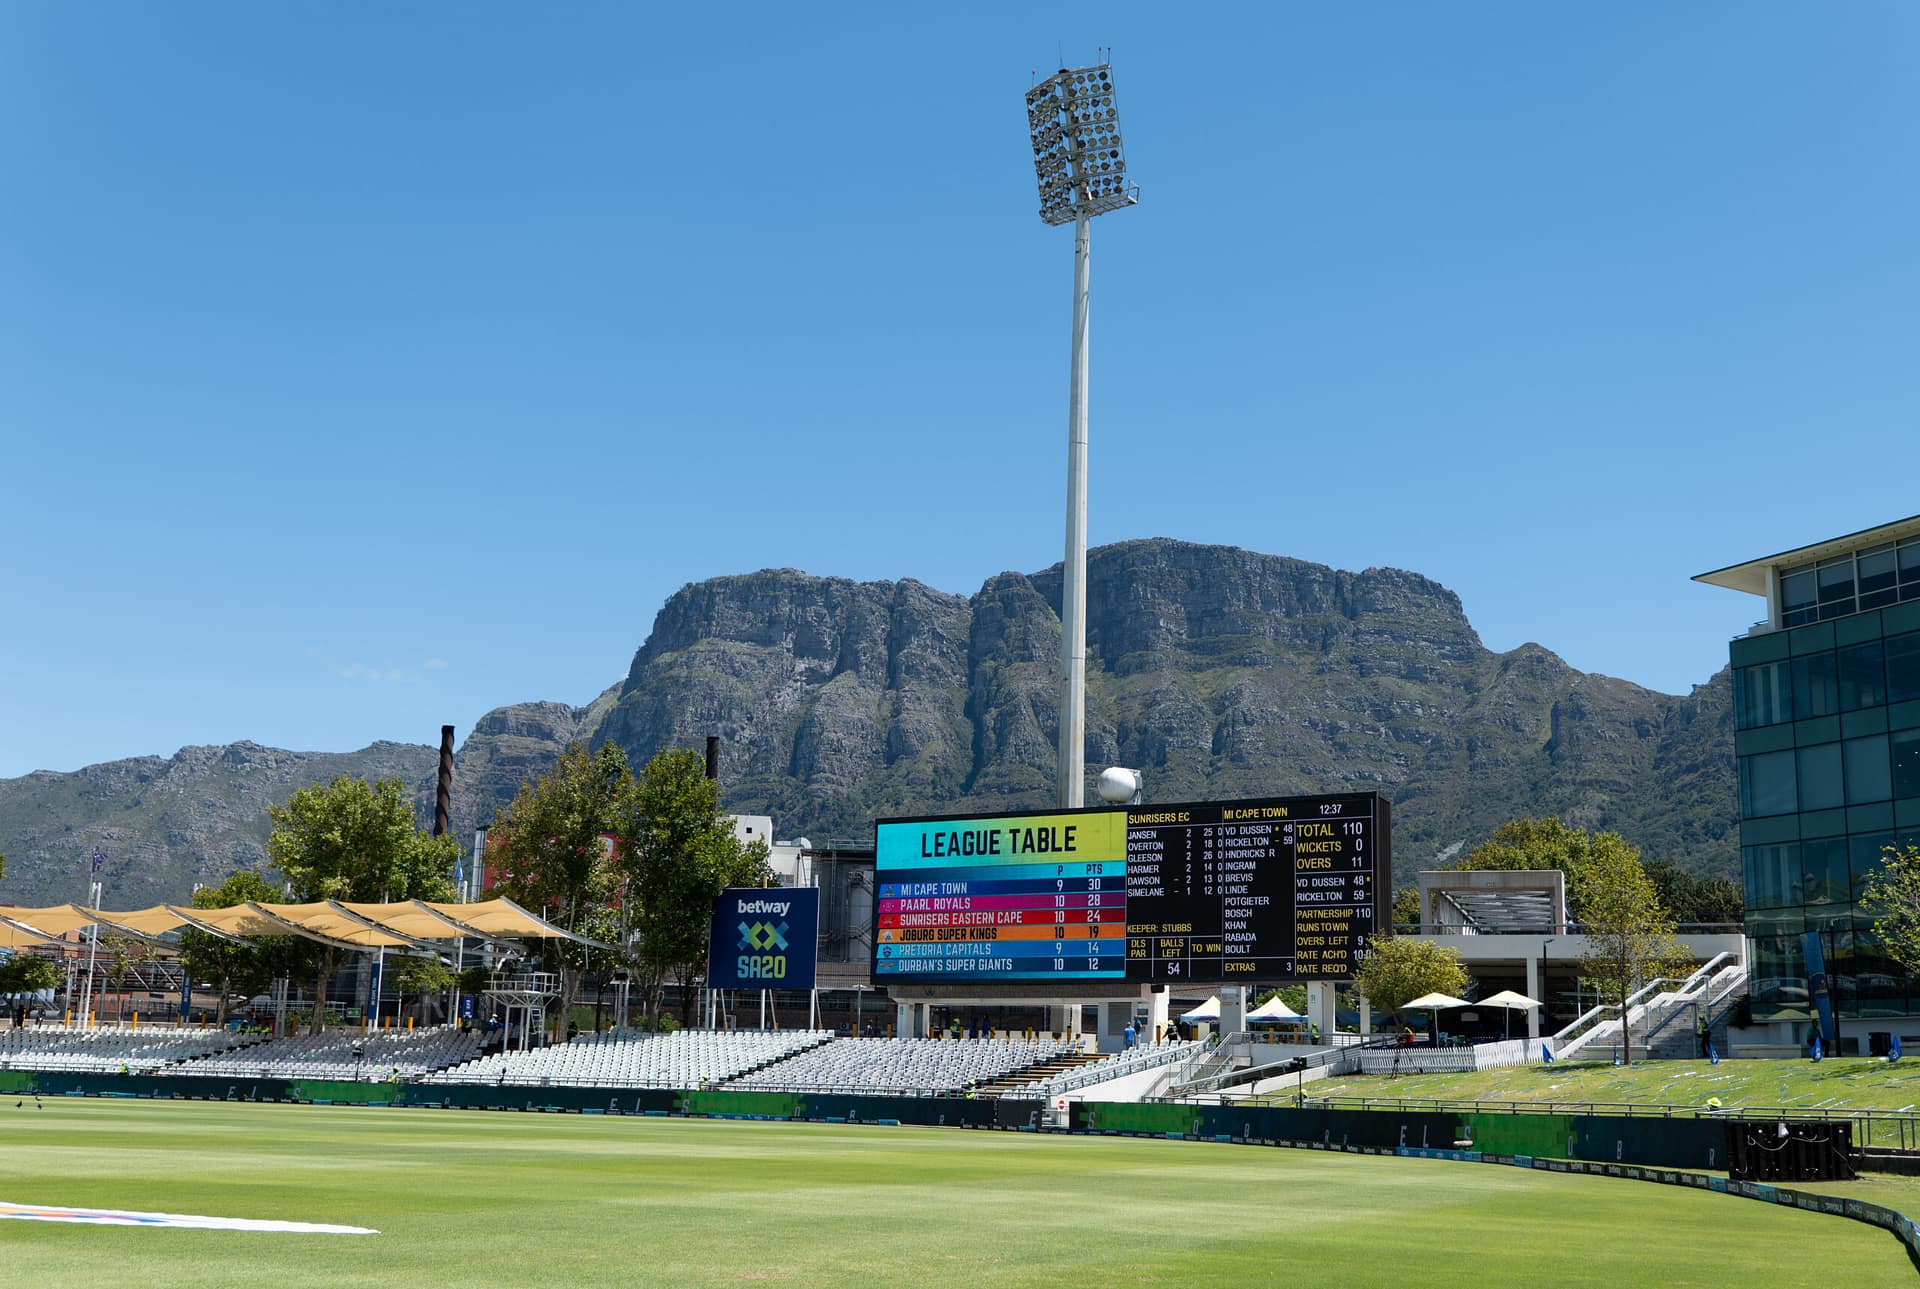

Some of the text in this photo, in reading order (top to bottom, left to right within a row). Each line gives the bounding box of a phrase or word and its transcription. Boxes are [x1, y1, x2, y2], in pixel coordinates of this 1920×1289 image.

[1224, 808, 1288, 819] MI CAPE TOWN
[1320, 804, 1342, 814] 12:37
[1128, 812, 1190, 824] SUNRISERS EC
[1128, 831, 1156, 839] JANSEN
[1186, 829, 1191, 837] 2
[1204, 828, 1212, 836] 25
[1240, 825, 1272, 834] DUSSEN
[1283, 824, 1293, 833] 48
[1297, 822, 1363, 837] TOTAL 110
[922, 826, 1077, 857] LEAGUE TABLE
[1225, 836, 1293, 846] RICKELTON 59
[1297, 839, 1362, 852] WICKETS 0
[1128, 842, 1164, 851] OVERTON
[1128, 853, 1162, 862] GLEESON
[1204, 851, 1213, 859] 26
[1225, 849, 1275, 858] HNDRICKS R
[1225, 862, 1256, 870] INGRAM
[1297, 857, 1362, 869] OVERS 11
[1058, 864, 1103, 876] P PTS
[1128, 865, 1159, 874] HARMER
[1217, 863, 1223, 871] 0
[1128, 876, 1160, 885] DAWSON
[1204, 874, 1212, 883] 13
[1225, 874, 1253, 882] BREVIS
[1297, 876, 1364, 887] VD DUSSEN 48
[901, 879, 1101, 895] MI CAPE TOWN 9 30
[1127, 888, 1165, 897] SIMELANE
[1204, 886, 1212, 895] 12
[1225, 886, 1248, 894] LINDE
[1225, 896, 1269, 906] POTGIETER
[1296, 891, 1364, 901] RICKELTON 59
[738, 899, 790, 916] betway
[900, 895, 1101, 910] PAARL ROYALS 10 28
[900, 910, 1101, 926] SUNRISERS EASTERN CAPE 10 24
[1225, 909, 1252, 918] BOSCH
[1296, 909, 1370, 918] PARTNERSHIP 110
[1127, 924, 1192, 933] KEEPER: STUBBS
[1225, 921, 1246, 930] KHAN
[1296, 923, 1348, 932] RUNS TO WIN
[900, 926, 1099, 941] JOBURG SUPER KINGS 10 19
[1225, 933, 1256, 941] RABADA
[1160, 939, 1184, 947] BALLS
[1297, 936, 1363, 946] OVERS LEFT 9
[899, 942, 1099, 956] PRETORIA CAPITALS 9 14
[1162, 948, 1181, 957] LEFT
[1192, 943, 1221, 952] TO WIN
[1225, 945, 1250, 953] BOULT
[1131, 950, 1146, 958] PAR
[1296, 950, 1318, 959] RATE
[737, 955, 786, 979] SA20
[898, 958, 1099, 971] DURBAN'S SUPER GIANTS 10 12
[1168, 962, 1180, 975] 54
[1225, 962, 1291, 971] EXTRAS 3
[1296, 964, 1318, 973] RATE
